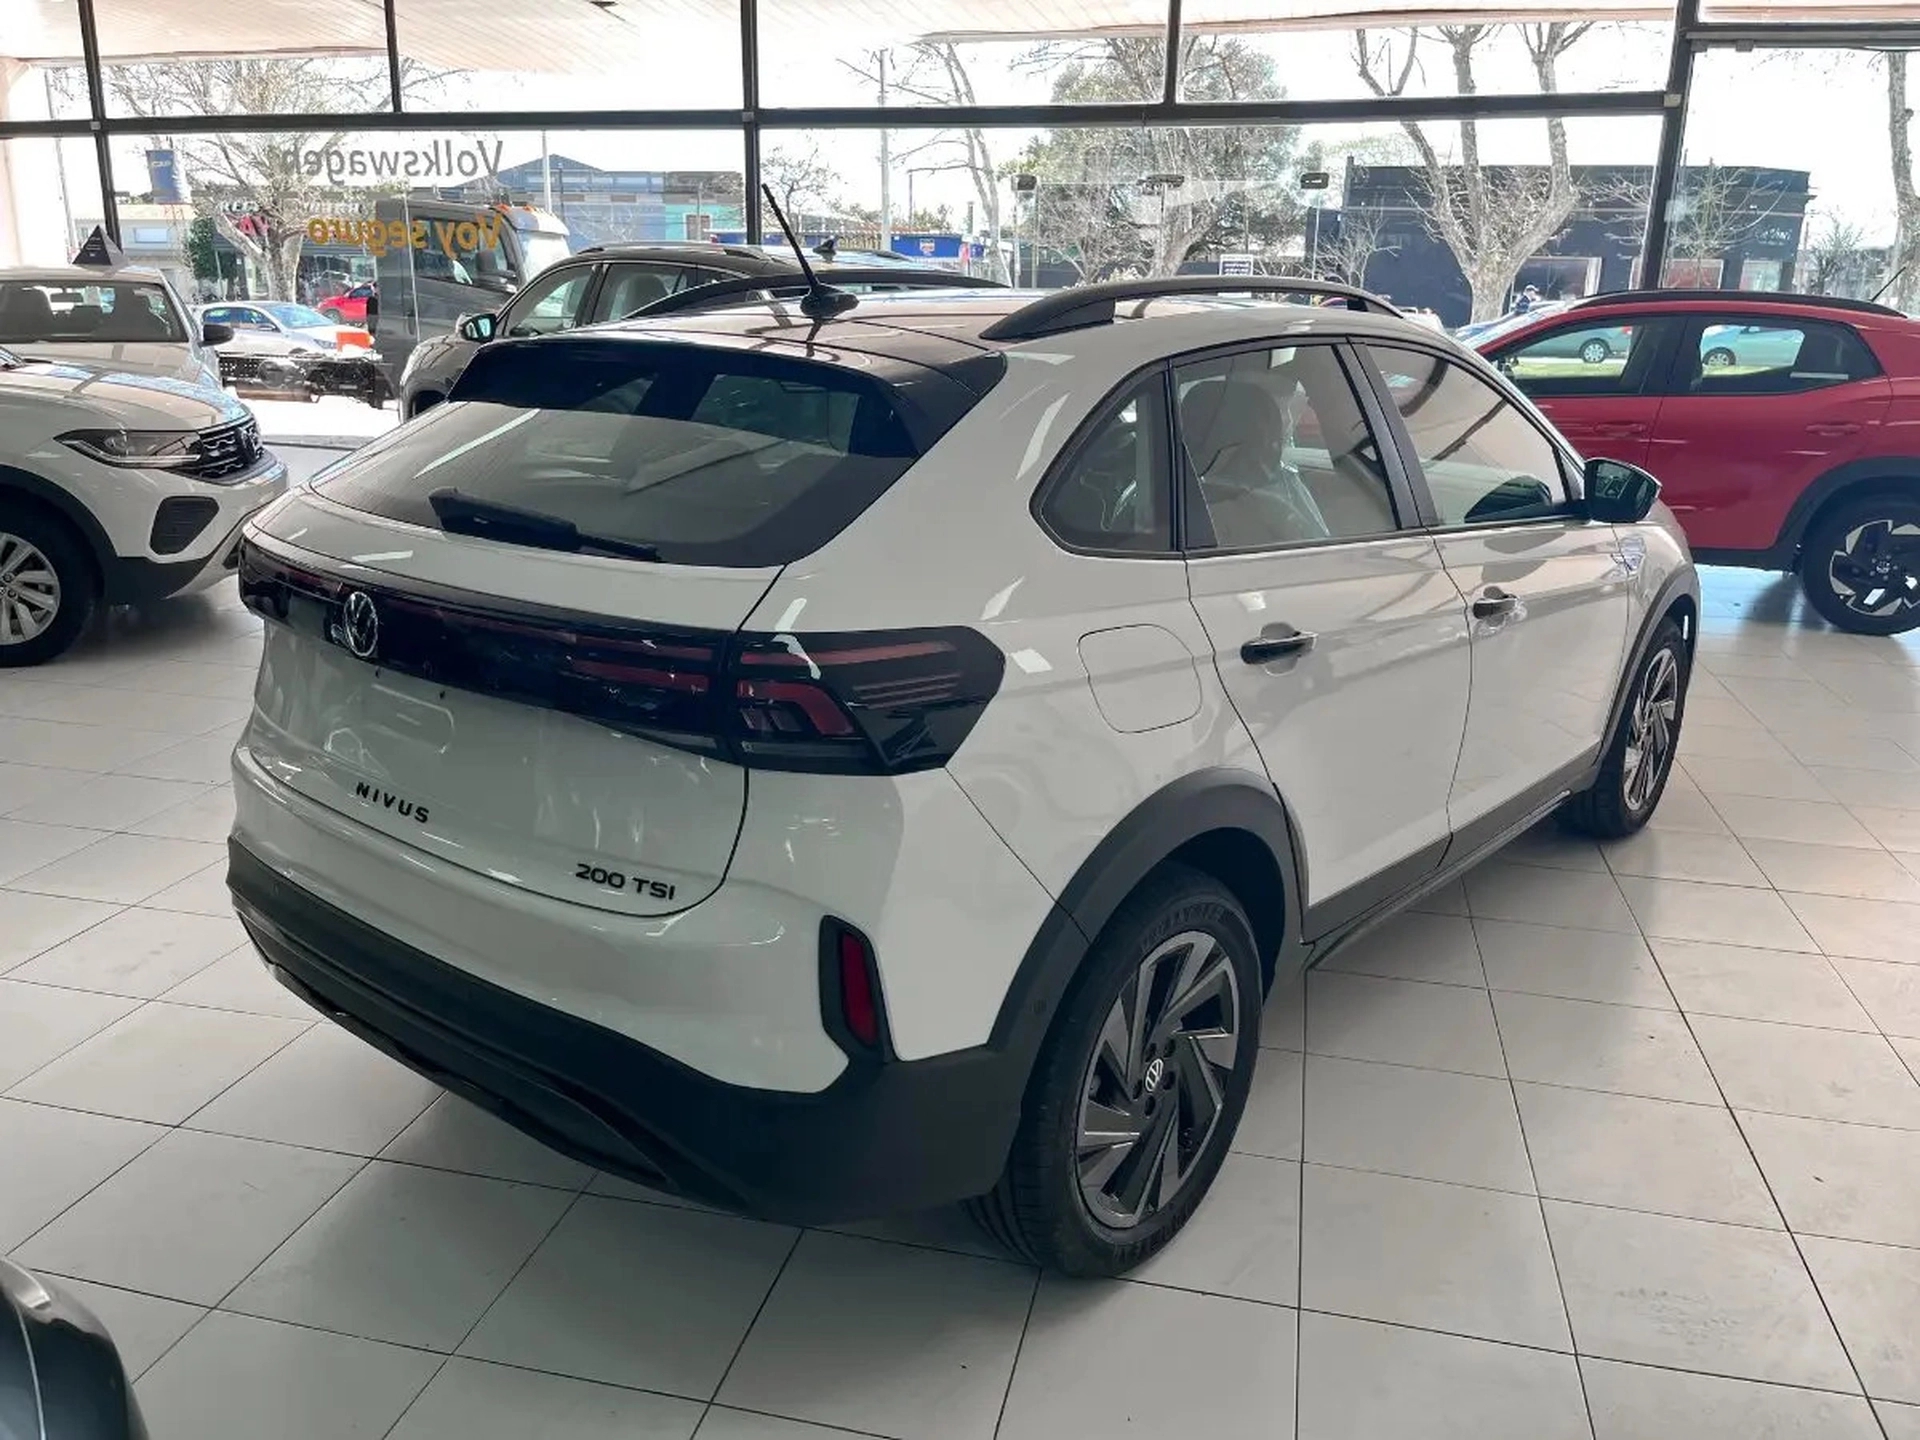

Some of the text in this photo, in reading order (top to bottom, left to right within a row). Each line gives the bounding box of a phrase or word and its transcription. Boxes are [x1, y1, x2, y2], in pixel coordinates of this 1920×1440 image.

[355, 780, 430, 824] NIVUS
[575, 863, 676, 901] 200 TSI
